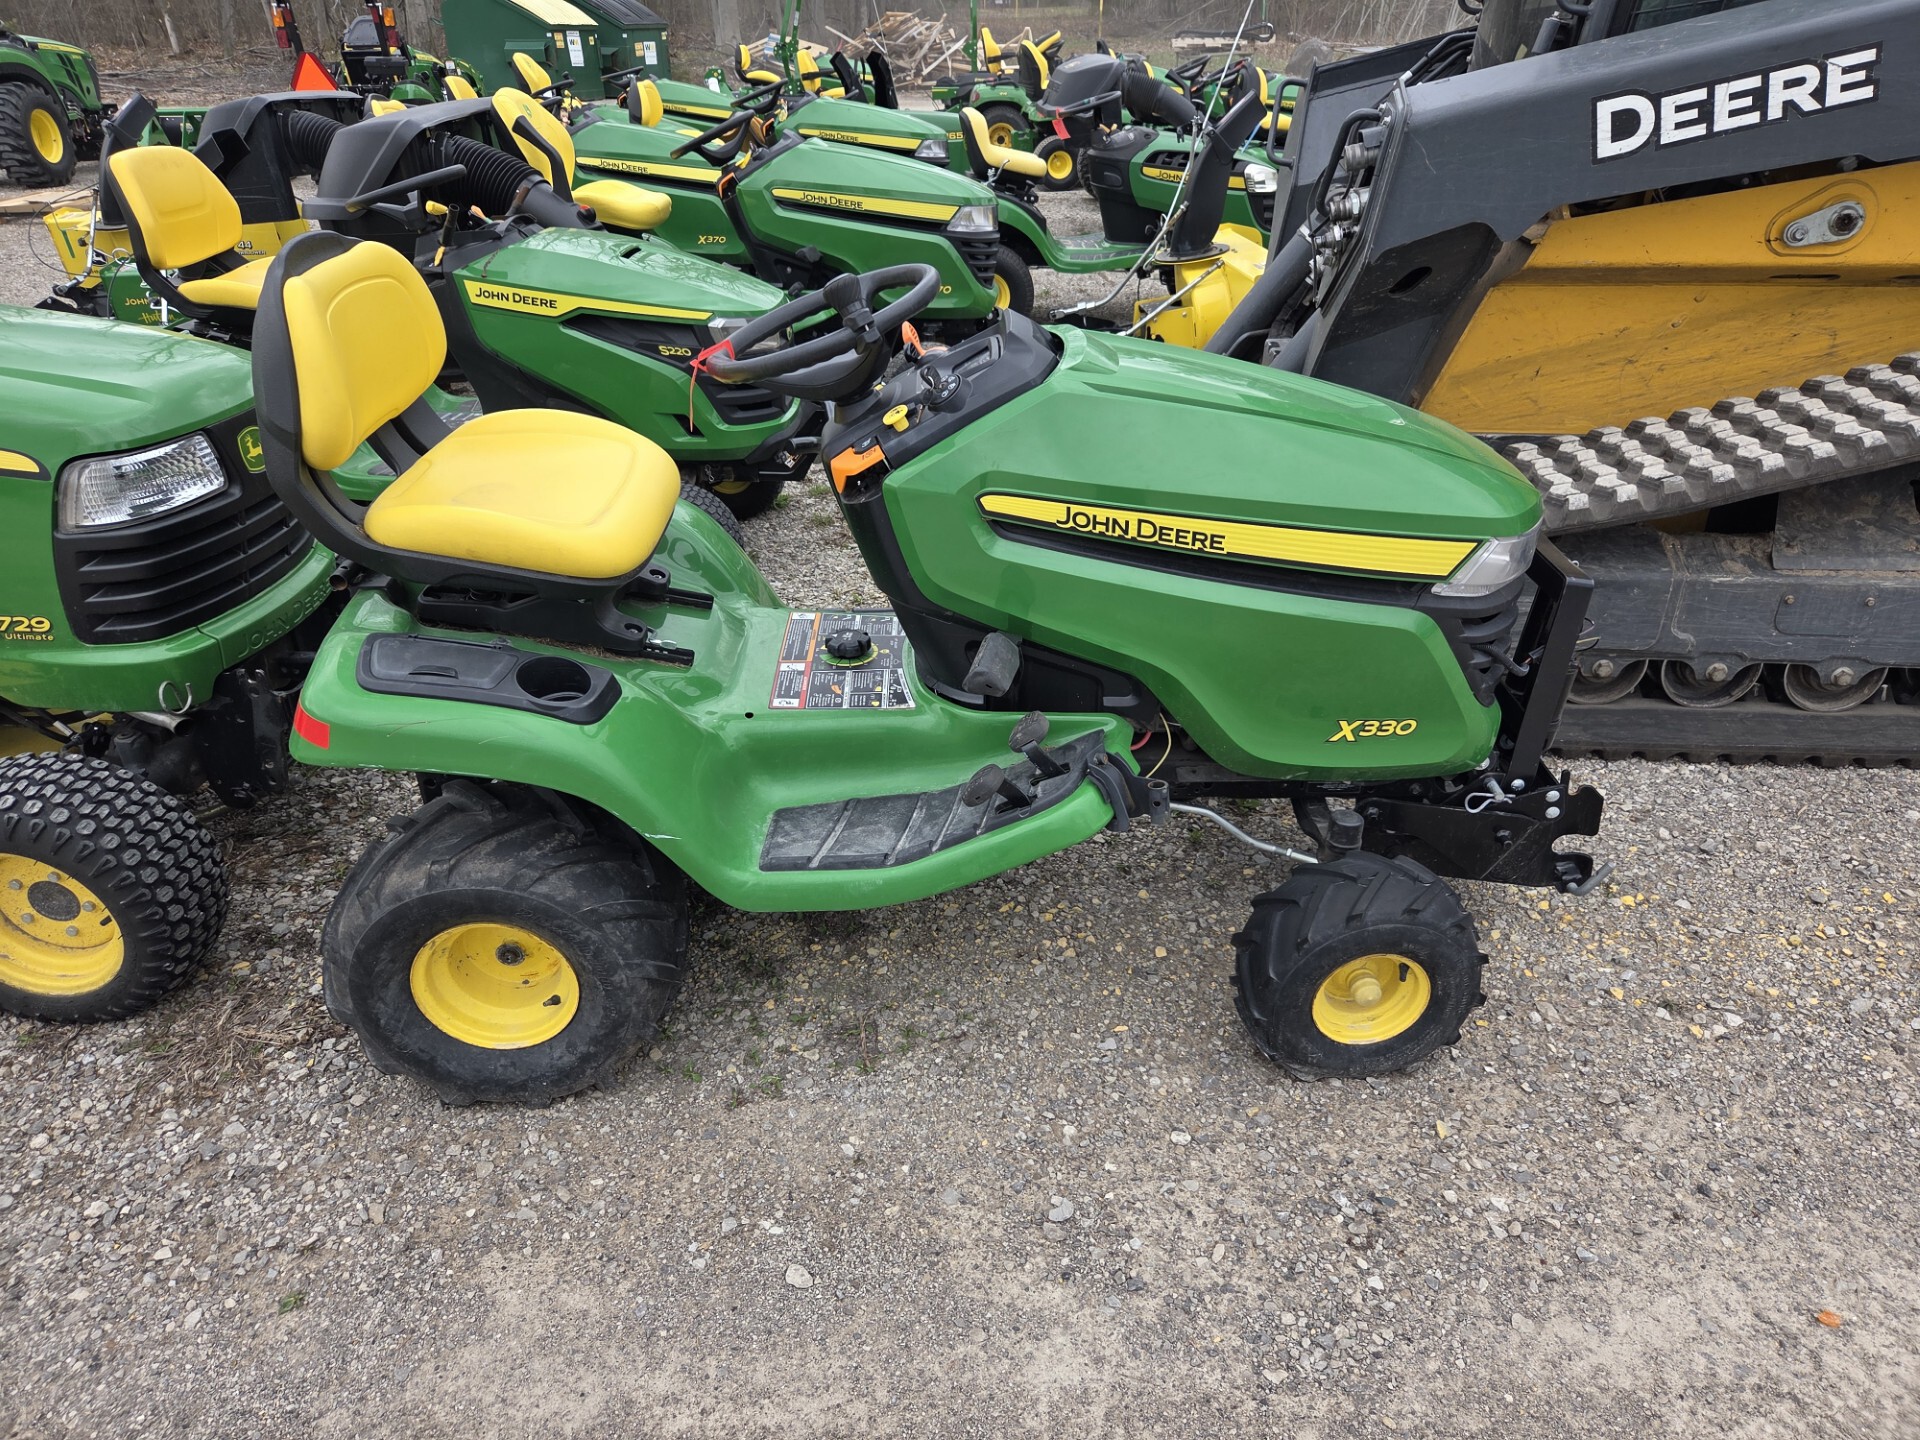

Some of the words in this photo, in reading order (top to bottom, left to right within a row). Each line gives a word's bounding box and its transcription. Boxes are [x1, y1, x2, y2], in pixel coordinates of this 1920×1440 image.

[1596, 48, 1877, 159] DEERE
[817, 130, 836, 141] JOHN
[836, 133, 859, 142] DEERE
[947, 131, 964, 139] 65
[599, 160, 620, 171] JOHN
[621, 163, 649, 174] DEERE
[800, 192, 828, 205] JOHN
[829, 197, 864, 210] DEERE
[237, 240, 253, 249] 44
[698, 235, 727, 245] X370
[475, 287, 510, 302] JOHN
[512, 292, 558, 309] DEERE
[658, 345, 692, 356] S220
[1056, 506, 1130, 537] JOHN
[1136, 518, 1227, 552] DEERE
[5, 633, 54, 641] Ultimate
[1326, 719, 1418, 742] X330
